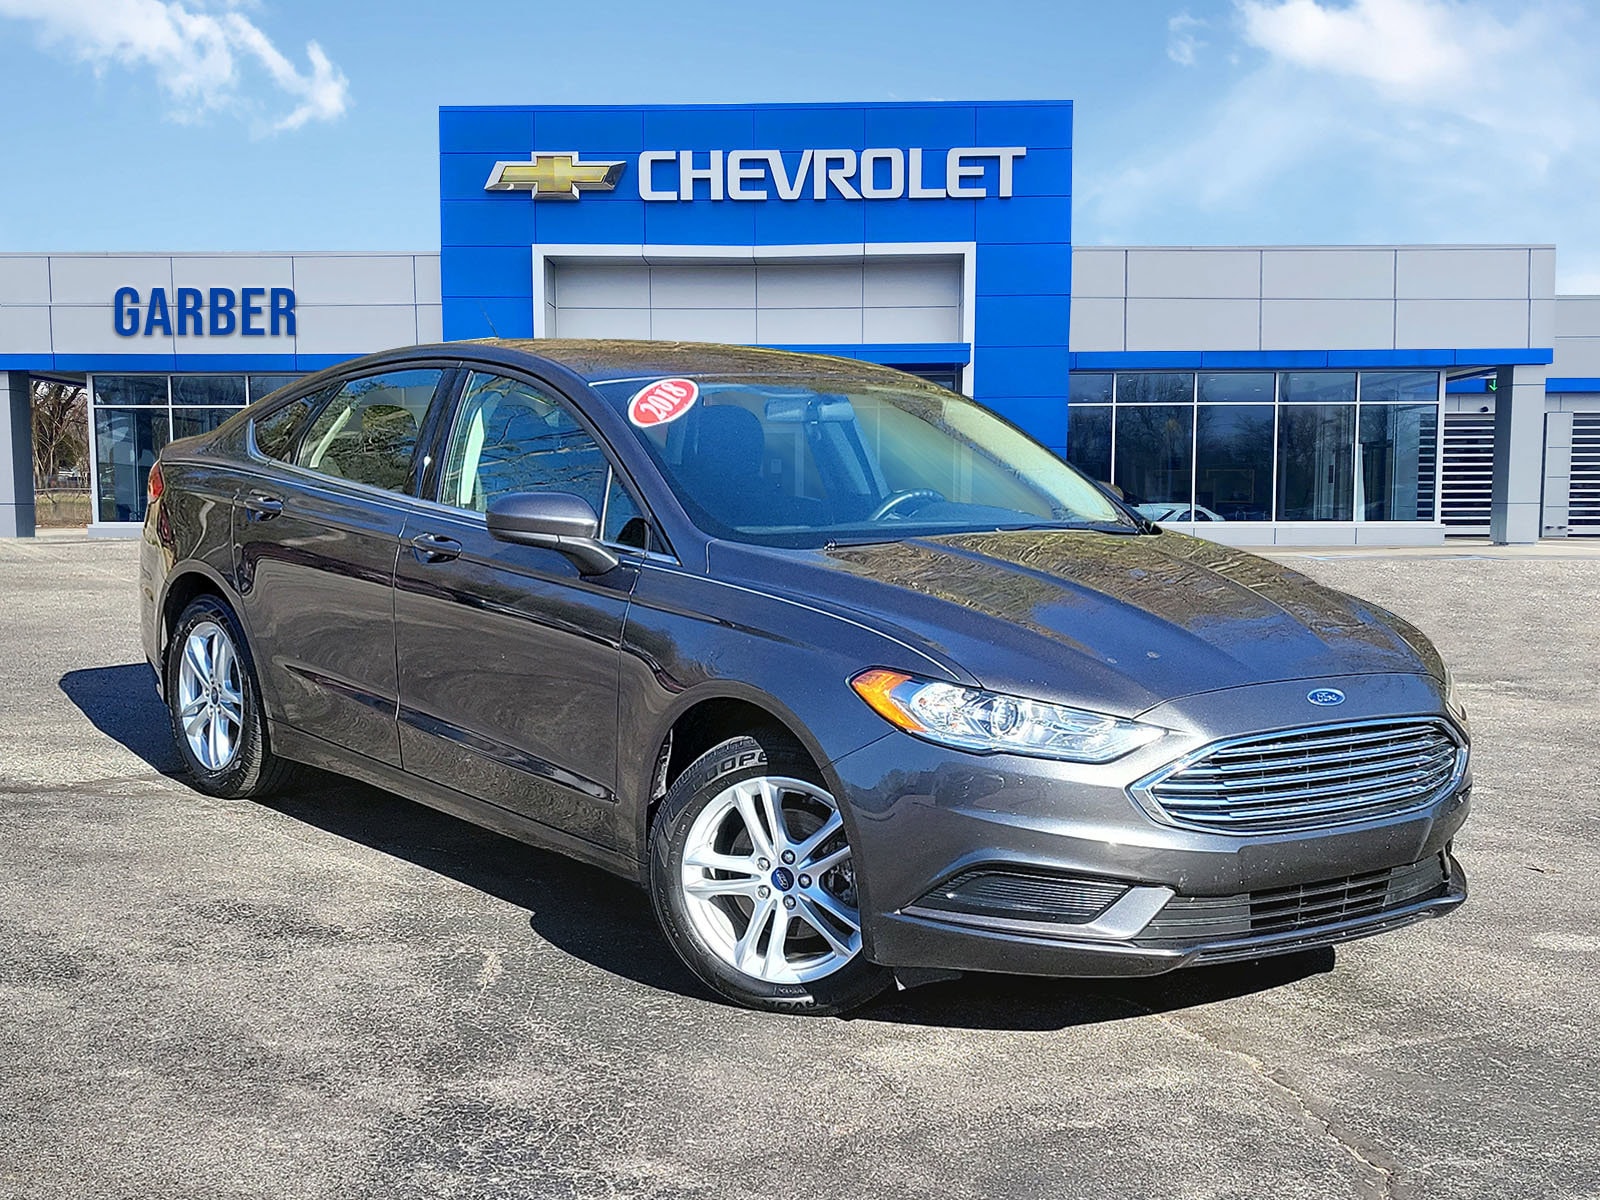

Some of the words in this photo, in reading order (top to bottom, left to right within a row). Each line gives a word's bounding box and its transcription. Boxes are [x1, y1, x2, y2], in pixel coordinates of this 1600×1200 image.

[638, 147, 1027, 200] CHEVROLET
[114, 287, 296, 336] GARBER
[639, 382, 688, 421] 2018
